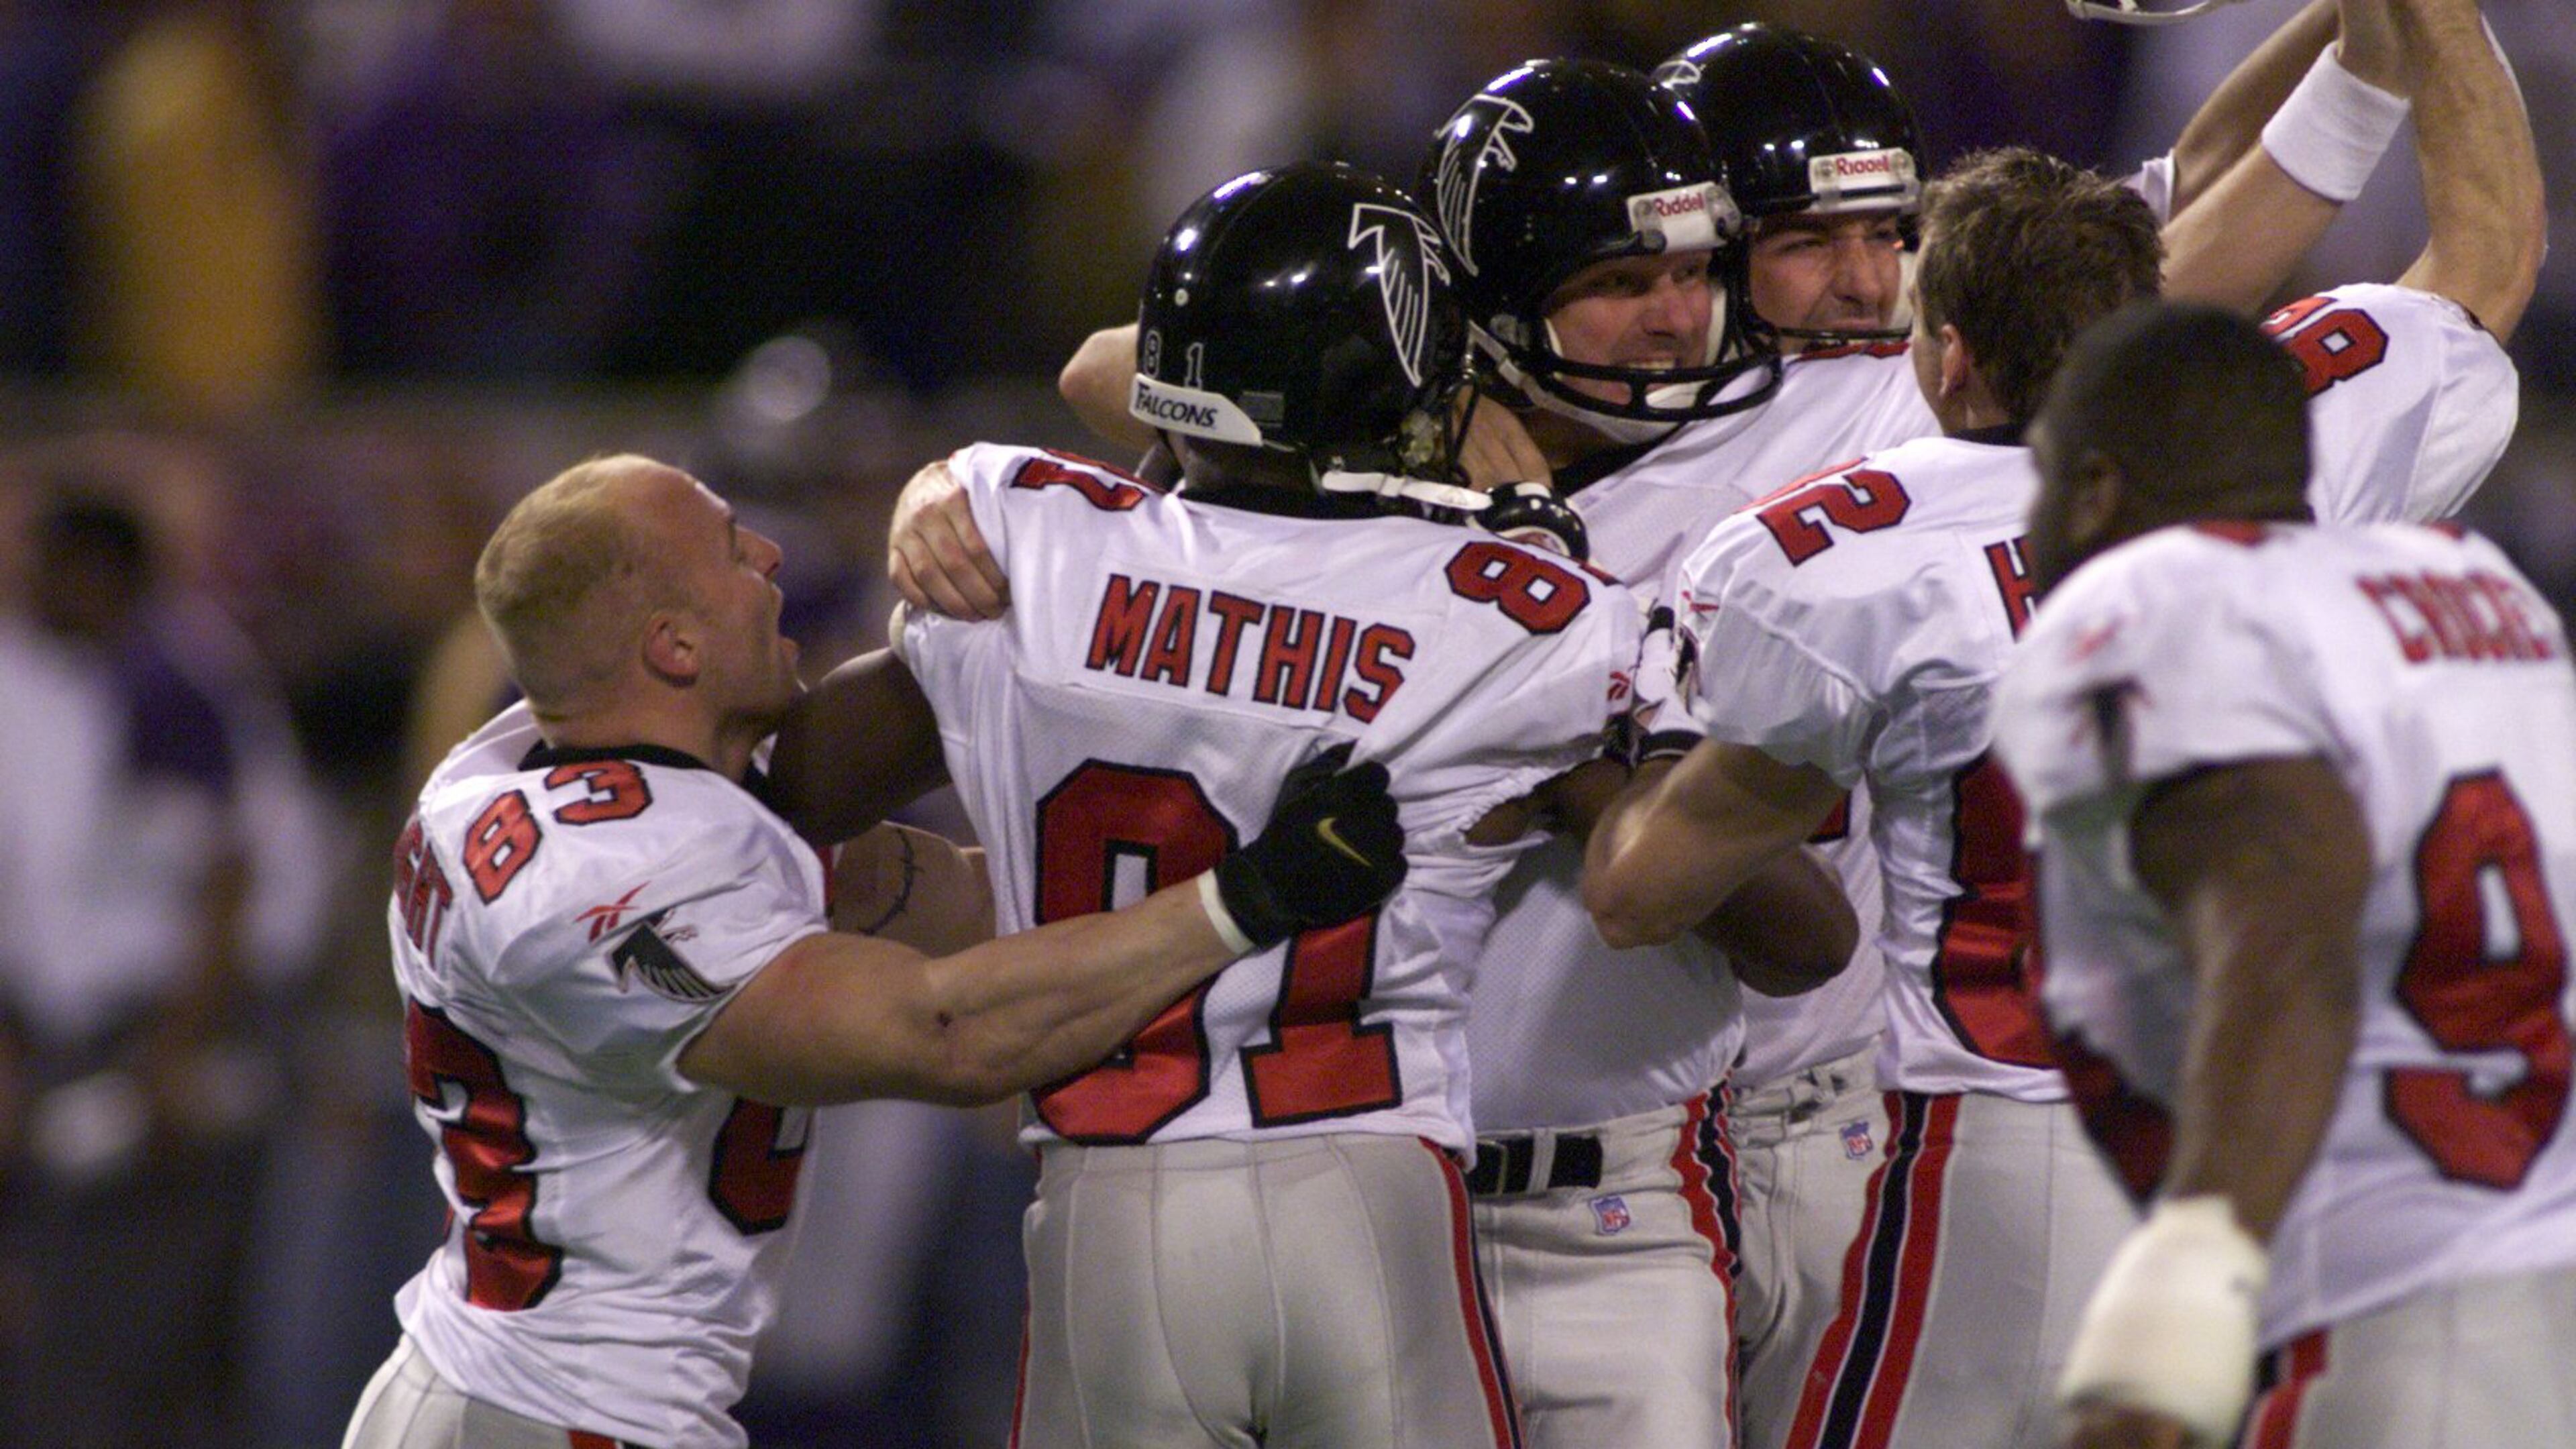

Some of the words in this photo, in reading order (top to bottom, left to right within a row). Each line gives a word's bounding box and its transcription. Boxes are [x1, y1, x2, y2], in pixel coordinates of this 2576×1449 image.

[1135, 380, 1218, 428] FALCONS
[1085, 572, 1415, 724] MATHIS
[463, 759, 653, 906] 83
[1034, 757, 1403, 1146] 81
[2379, 766, 2572, 1191] 9
